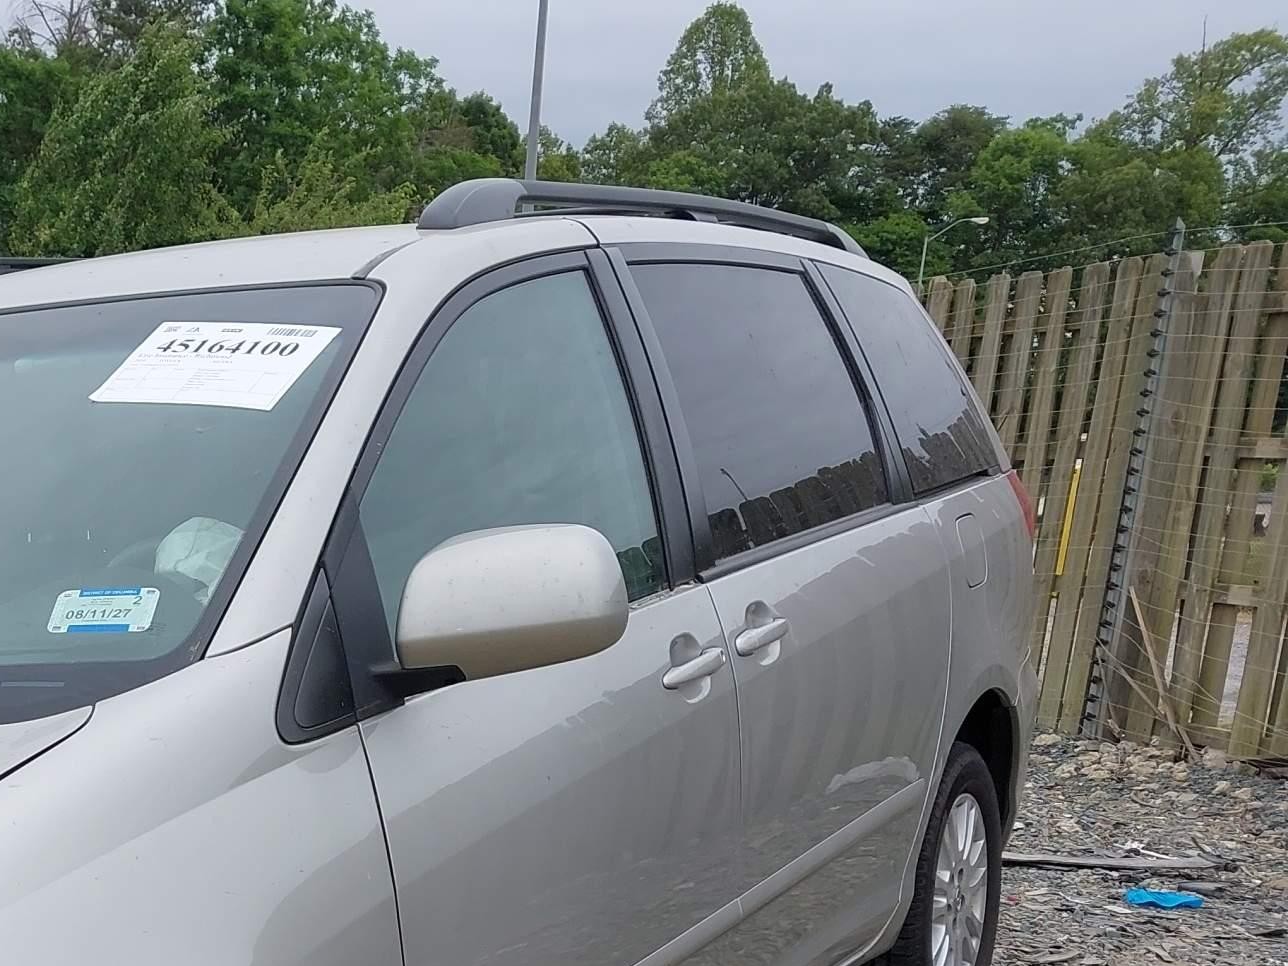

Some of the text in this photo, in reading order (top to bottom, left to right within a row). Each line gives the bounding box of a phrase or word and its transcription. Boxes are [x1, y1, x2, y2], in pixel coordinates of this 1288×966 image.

[157, 338, 300, 357] 45164100
[132, 595, 143, 605] 2
[65, 608, 132, 620] 08/11/27
